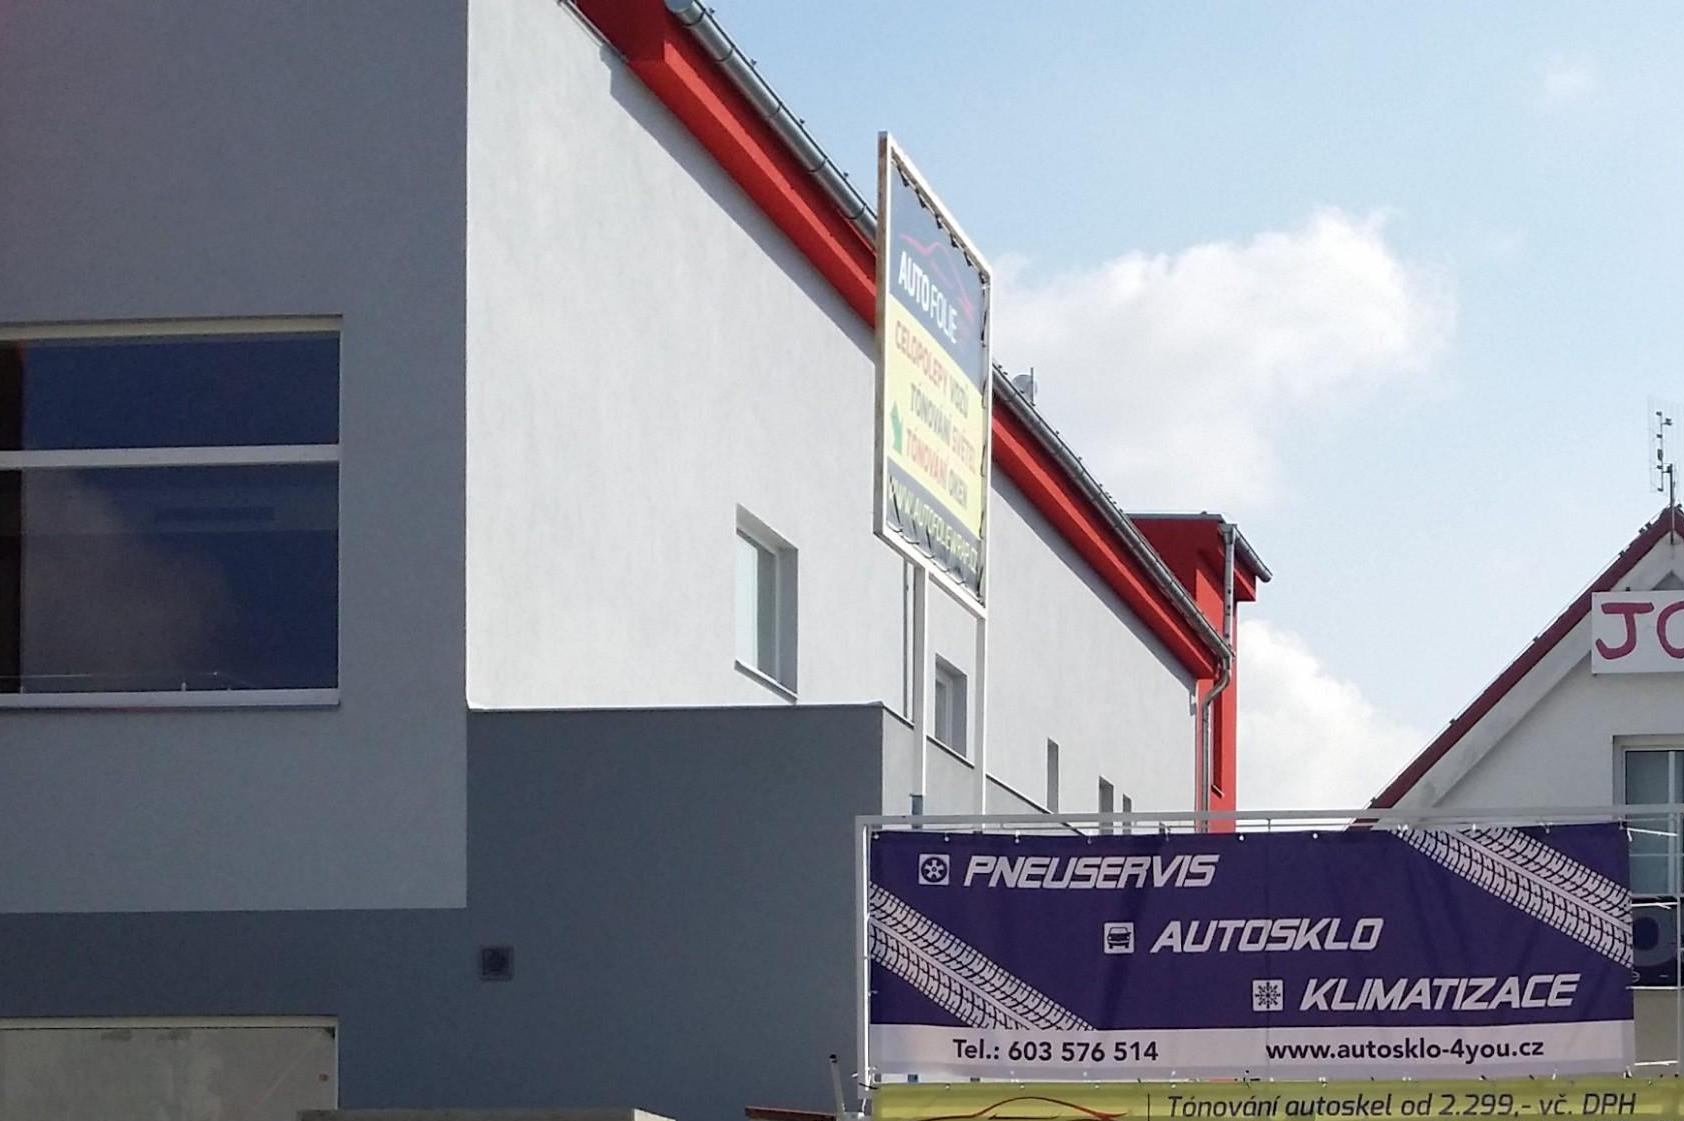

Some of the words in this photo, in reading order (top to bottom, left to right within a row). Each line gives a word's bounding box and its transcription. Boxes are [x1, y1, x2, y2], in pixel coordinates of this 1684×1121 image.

[898, 251, 930, 312] AUTO
[930, 283, 958, 344] FOLIE
[963, 854, 1219, 889] PNEUSERVIS
[1150, 918, 1384, 953] AUTOSKLO
[1300, 974, 1581, 1012] KLIMATIZACE
[953, 1039, 1000, 1062] Tel.:
[1008, 1040, 1054, 1062] 603
[1060, 1040, 1106, 1062] 576
[1113, 1040, 1159, 1062] 514
[1265, 1037, 1545, 1065] www.autosklo-4you.cz
[1167, 1095, 1282, 1117] Tónování
[1284, 1093, 1392, 1117] autoskel
[1400, 1093, 1433, 1116] od
[1438, 1094, 1531, 1118] 2.299,-
[1539, 1094, 1573, 1115] vč.
[1583, 1093, 1636, 1115] DPH
